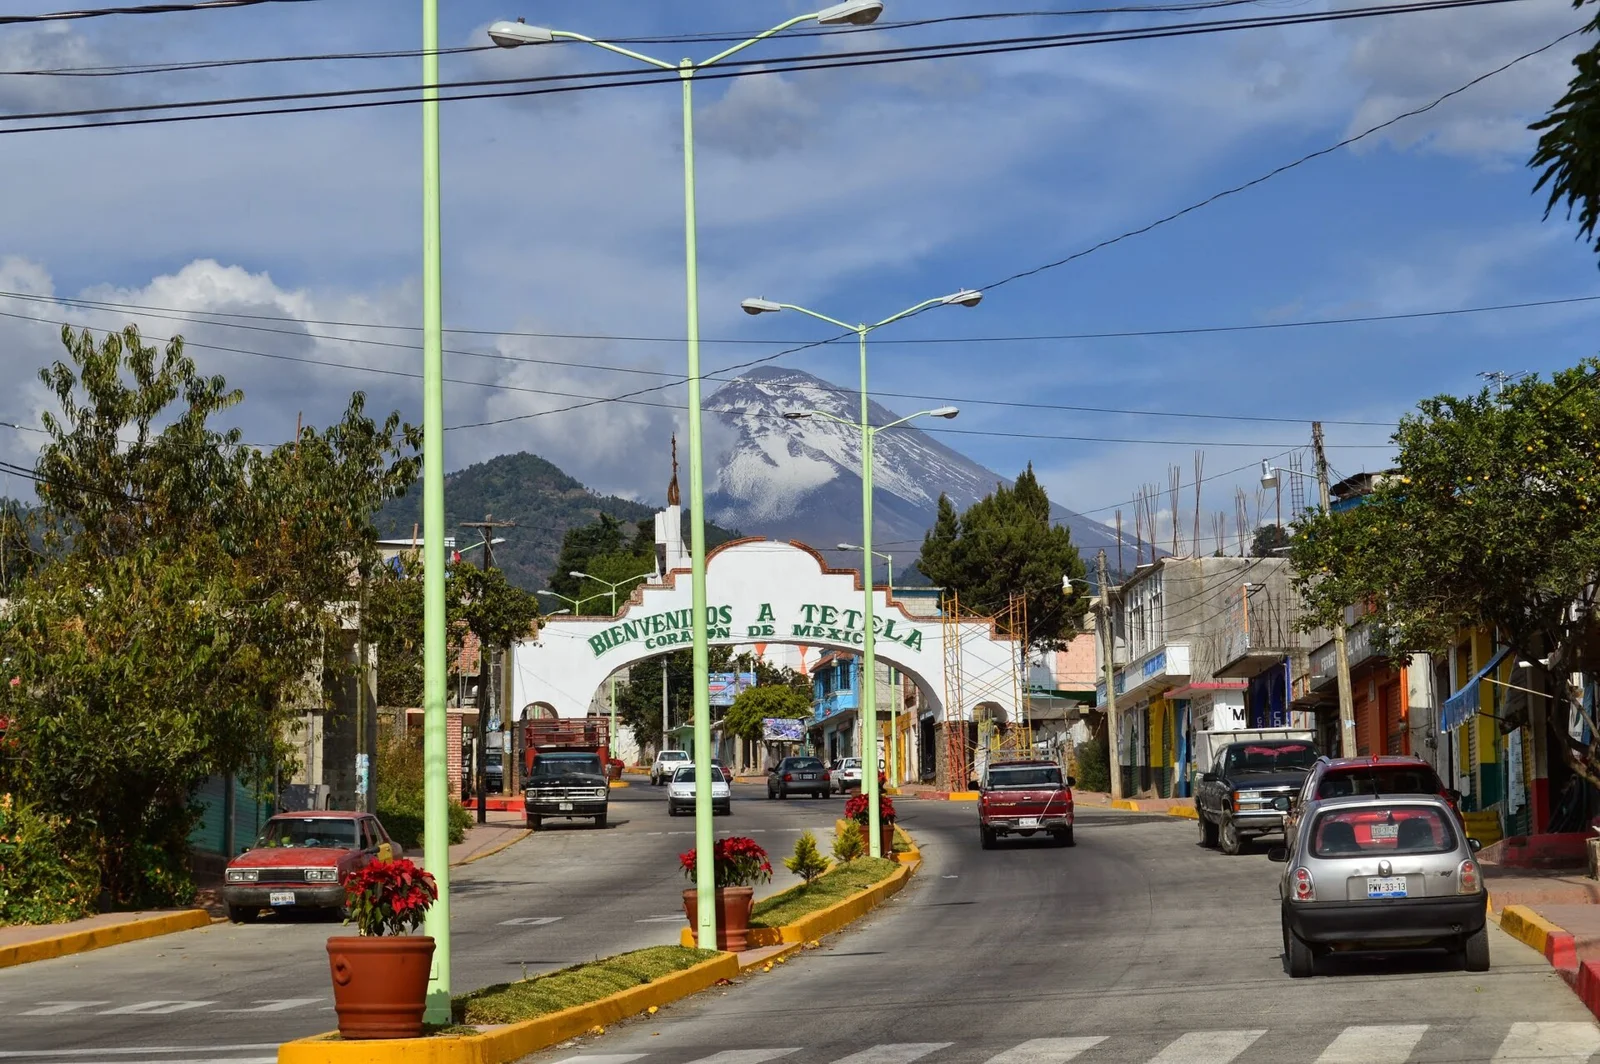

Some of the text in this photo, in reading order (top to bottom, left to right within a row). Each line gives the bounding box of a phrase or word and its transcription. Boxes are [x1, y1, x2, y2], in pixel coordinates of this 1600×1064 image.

[587, 604, 732, 657] BIENVENIOS
[756, 602, 776, 622] A
[747, 624, 775, 637] DE
[792, 623, 877, 646] MÉXIC
[1368, 882, 1406, 892] PWV-33-13
